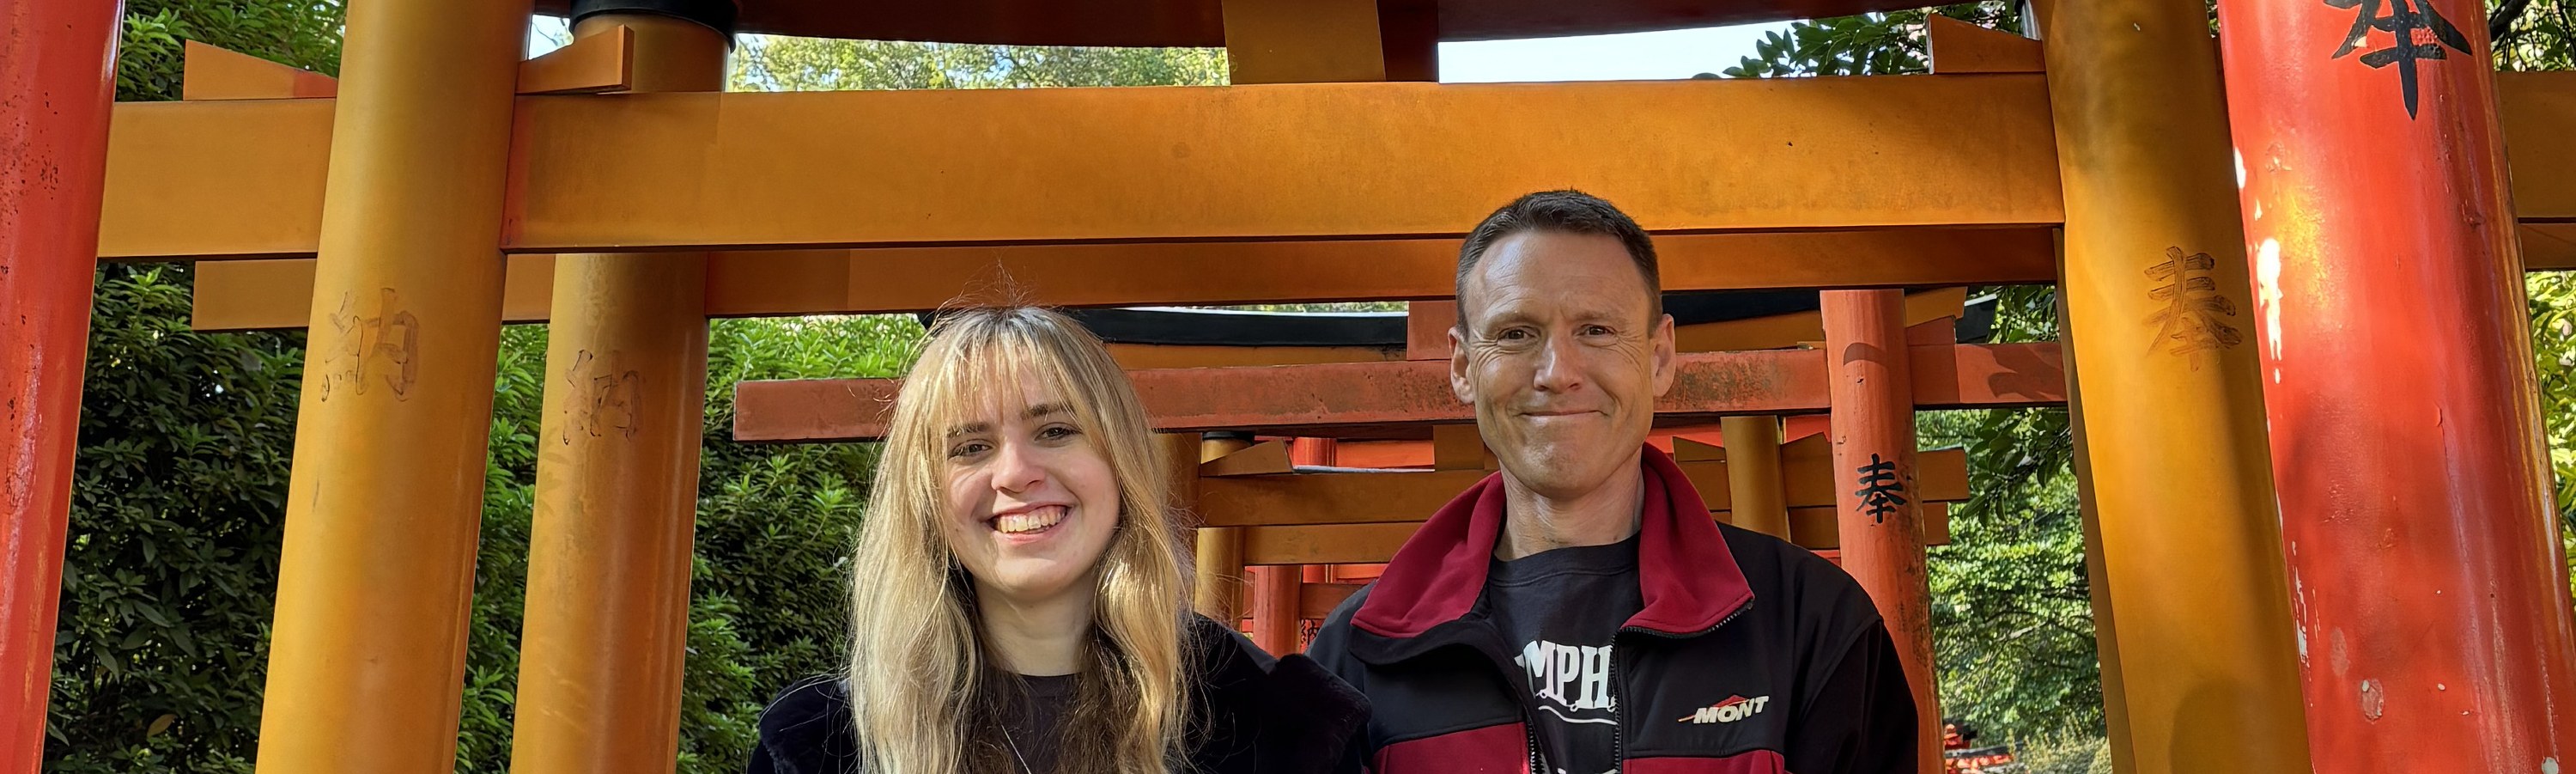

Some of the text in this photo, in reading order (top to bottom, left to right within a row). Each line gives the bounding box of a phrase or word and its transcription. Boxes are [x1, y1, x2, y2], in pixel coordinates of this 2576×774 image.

[321, 287, 420, 402] 納
[1855, 453, 1907, 524] 奉
[1514, 640, 1616, 712] MPH
[1692, 695, 1770, 724] MONT
